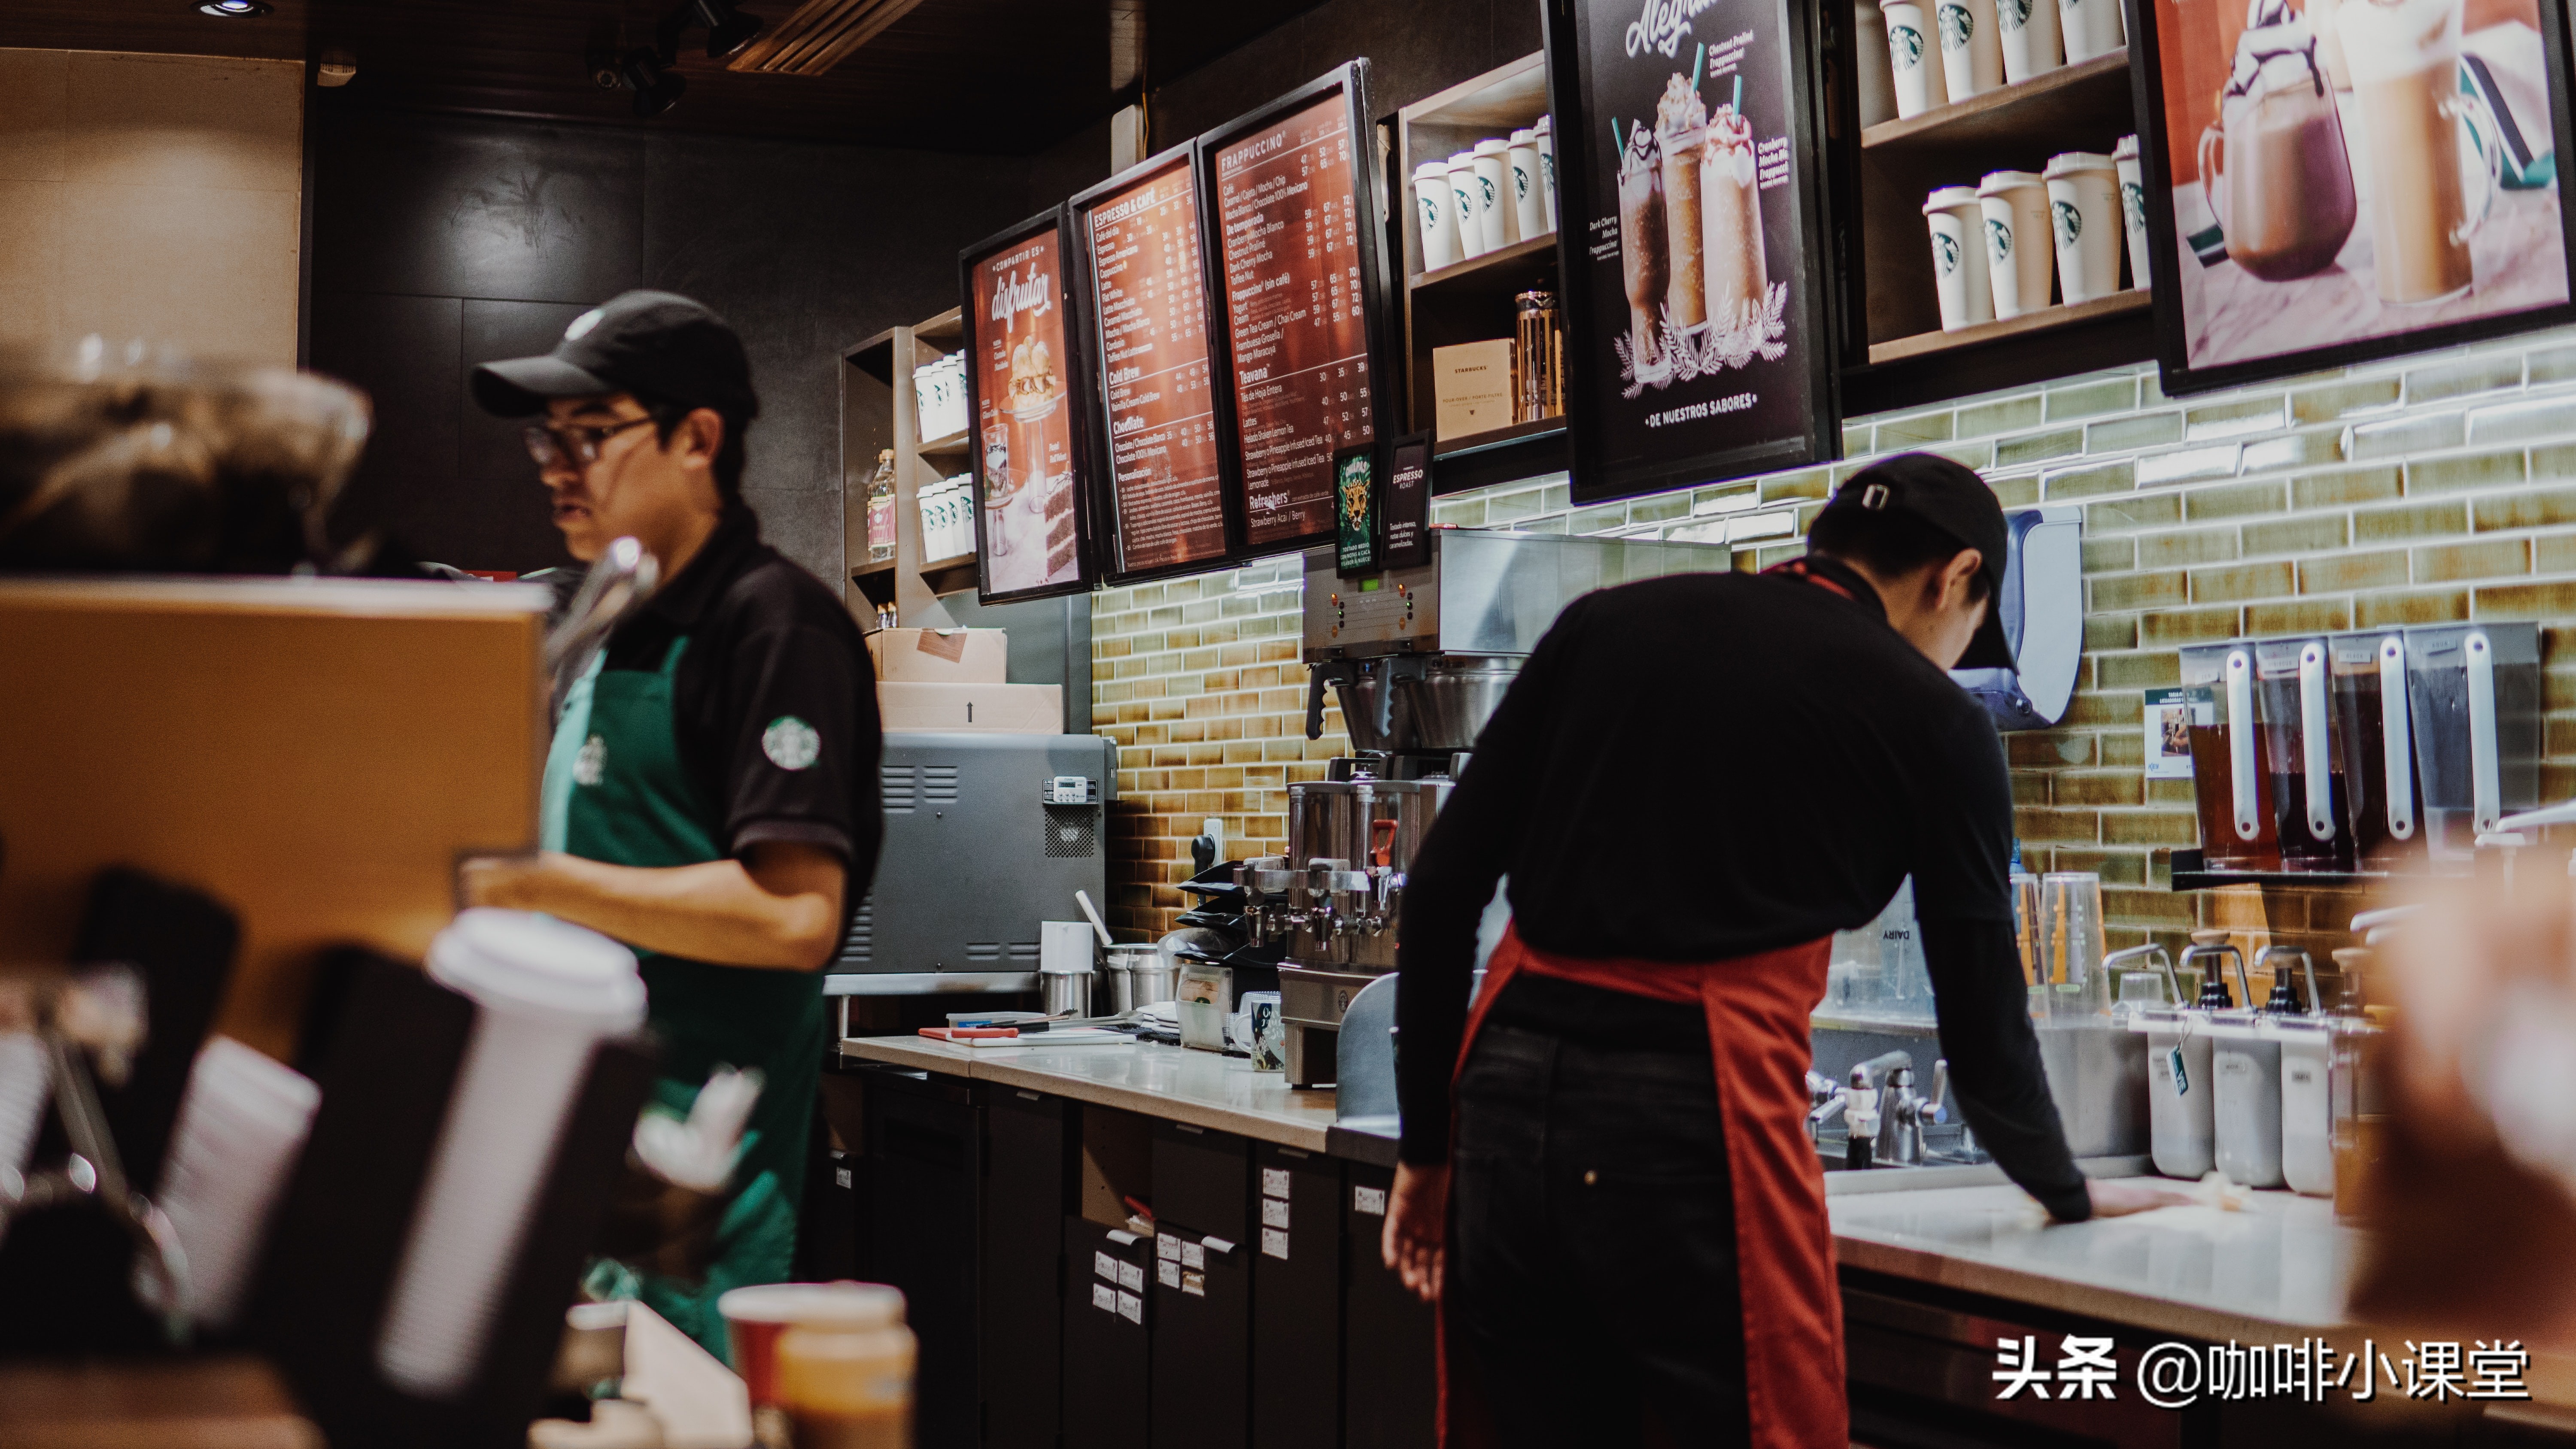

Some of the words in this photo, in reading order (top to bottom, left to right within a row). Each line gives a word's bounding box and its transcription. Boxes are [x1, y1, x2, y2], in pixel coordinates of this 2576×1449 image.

[1709, 39, 1733, 57] Chestnut
[1758, 137, 1788, 155] Cranberry
[1759, 152, 1778, 167] Mocha
[1223, 184, 1234, 196] Café
[1224, 192, 1239, 208] Caramel
[1242, 188, 1255, 200] Cajeta
[1258, 181, 1273, 193] Mocha
[1275, 175, 1285, 187] Chip
[1094, 202, 1130, 227] ESPRESSO
[1130, 199, 1136, 212] &
[1137, 187, 1156, 209] CAFÉ
[1225, 208, 1238, 221] Mocha
[1238, 203, 1251, 216] Blanco
[1254, 194, 1275, 209] Chocolate
[1275, 188, 1287, 201] 100%
[1287, 182, 1308, 196] Mexicano
[1226, 224, 1234, 236] De
[1234, 212, 1264, 233] temporada
[1590, 219, 1601, 230] Dark
[1601, 216, 1617, 227] Cherry
[1096, 231, 1105, 243] Café
[1227, 234, 1250, 249] Cranberry
[1250, 226, 1266, 238] Mocha
[1267, 221, 1284, 233] Blanco
[1602, 227, 1617, 239] Mocha
[1097, 242, 1115, 255] Espresso
[1228, 246, 1249, 261] Chestnut
[1249, 238, 1266, 252] Praliné
[1589, 240, 1616, 255] Frappuccino
[996, 250, 1030, 272] COMPARTIR
[1031, 246, 1039, 257] ES
[1099, 254, 1115, 267] Espresso
[1229, 261, 1240, 273] Dark
[1240, 257, 1256, 269] Cherry
[1256, 249, 1273, 263] Mocha
[1100, 264, 1123, 279] Cappuccino
[1230, 273, 1245, 285] Toffee
[1245, 269, 1254, 280] Nut
[1101, 281, 1112, 291] Latte
[1265, 278, 1275, 291] (sin
[1276, 272, 1290, 287] café)
[991, 262, 1051, 333] disfrutar
[1233, 301, 1248, 315] Yogurt
[1234, 314, 1249, 325] Cream
[1235, 327, 1249, 339] Green
[1249, 324, 1258, 333] Tea
[1258, 320, 1273, 331] Cream
[1277, 312, 1289, 324] Chai
[1289, 309, 1306, 321] Cream
[1236, 337, 1261, 351] Frambuesa
[1261, 330, 1280, 343] Grosella
[1237, 352, 1252, 363] Mango
[1253, 343, 1276, 359] Maracuyá
[1109, 369, 1123, 385] Cold
[1123, 367, 1139, 380] Brew
[1239, 367, 1267, 385] Teavana
[1319, 372, 1326, 382] 30
[1338, 367, 1344, 377] 35
[1358, 362, 1364, 373] 39
[1110, 389, 1120, 400] Cold
[1120, 388, 1131, 397] Brew
[1249, 391, 1255, 400] de
[1255, 387, 1266, 399] Hoja
[1267, 385, 1282, 396] Entera
[1340, 391, 1347, 402] 50
[1360, 388, 1367, 397] 55
[1111, 400, 1126, 412] Vainilla
[1126, 398, 1139, 408] Cream
[1139, 392, 1149, 404] Cold
[1149, 392, 1160, 401] Brew
[1650, 413, 1661, 427] DE
[1663, 402, 1708, 424] NUESTROS
[1710, 393, 1752, 415] SABORES
[1242, 417, 1257, 427] Lattes
[1342, 412, 1349, 421] 52
[1361, 407, 1368, 417] 57
[1113, 415, 1144, 434] Chocolate
[1194, 424, 1200, 433] 50
[1207, 421, 1213, 430] 56
[1344, 430, 1350, 440] 45
[1363, 425, 1370, 435] 50
[1115, 441, 1133, 452] Chocolate
[1135, 436, 1153, 447] Chocolate
[1153, 433, 1165, 443] Blanco
[1244, 432, 1258, 444] Helado
[1258, 429, 1272, 441] Shaken
[1272, 427, 1286, 437] Lemon
[1116, 452, 1136, 464] Chocolate
[1135, 449, 1147, 459] 100%
[1147, 446, 1166, 457] Mexicano
[1245, 449, 1266, 461] Strawberry
[1270, 443, 1290, 454] Pineapple
[1290, 438, 1305, 450] Infused
[1305, 436, 1315, 447] Iced
[1246, 467, 1268, 479] Strawberry
[1271, 461, 1291, 473] Pineapple
[1292, 458, 1306, 468] Infused
[1306, 454, 1316, 466] Iced
[1316, 453, 1324, 463] Tea
[1118, 467, 1151, 482] Personalización
[1393, 469, 1423, 484] ESPRESSO
[1248, 478, 1269, 490] Lemonade
[1400, 480, 1414, 489] ROAST
[1251, 515, 1276, 527] Strawberry
[1292, 510, 1305, 521] Berry
[1390, 521, 1402, 530] Tostado
[2148, 763, 2159, 771] KEY
[1883, 930, 1909, 939] DAIRY
